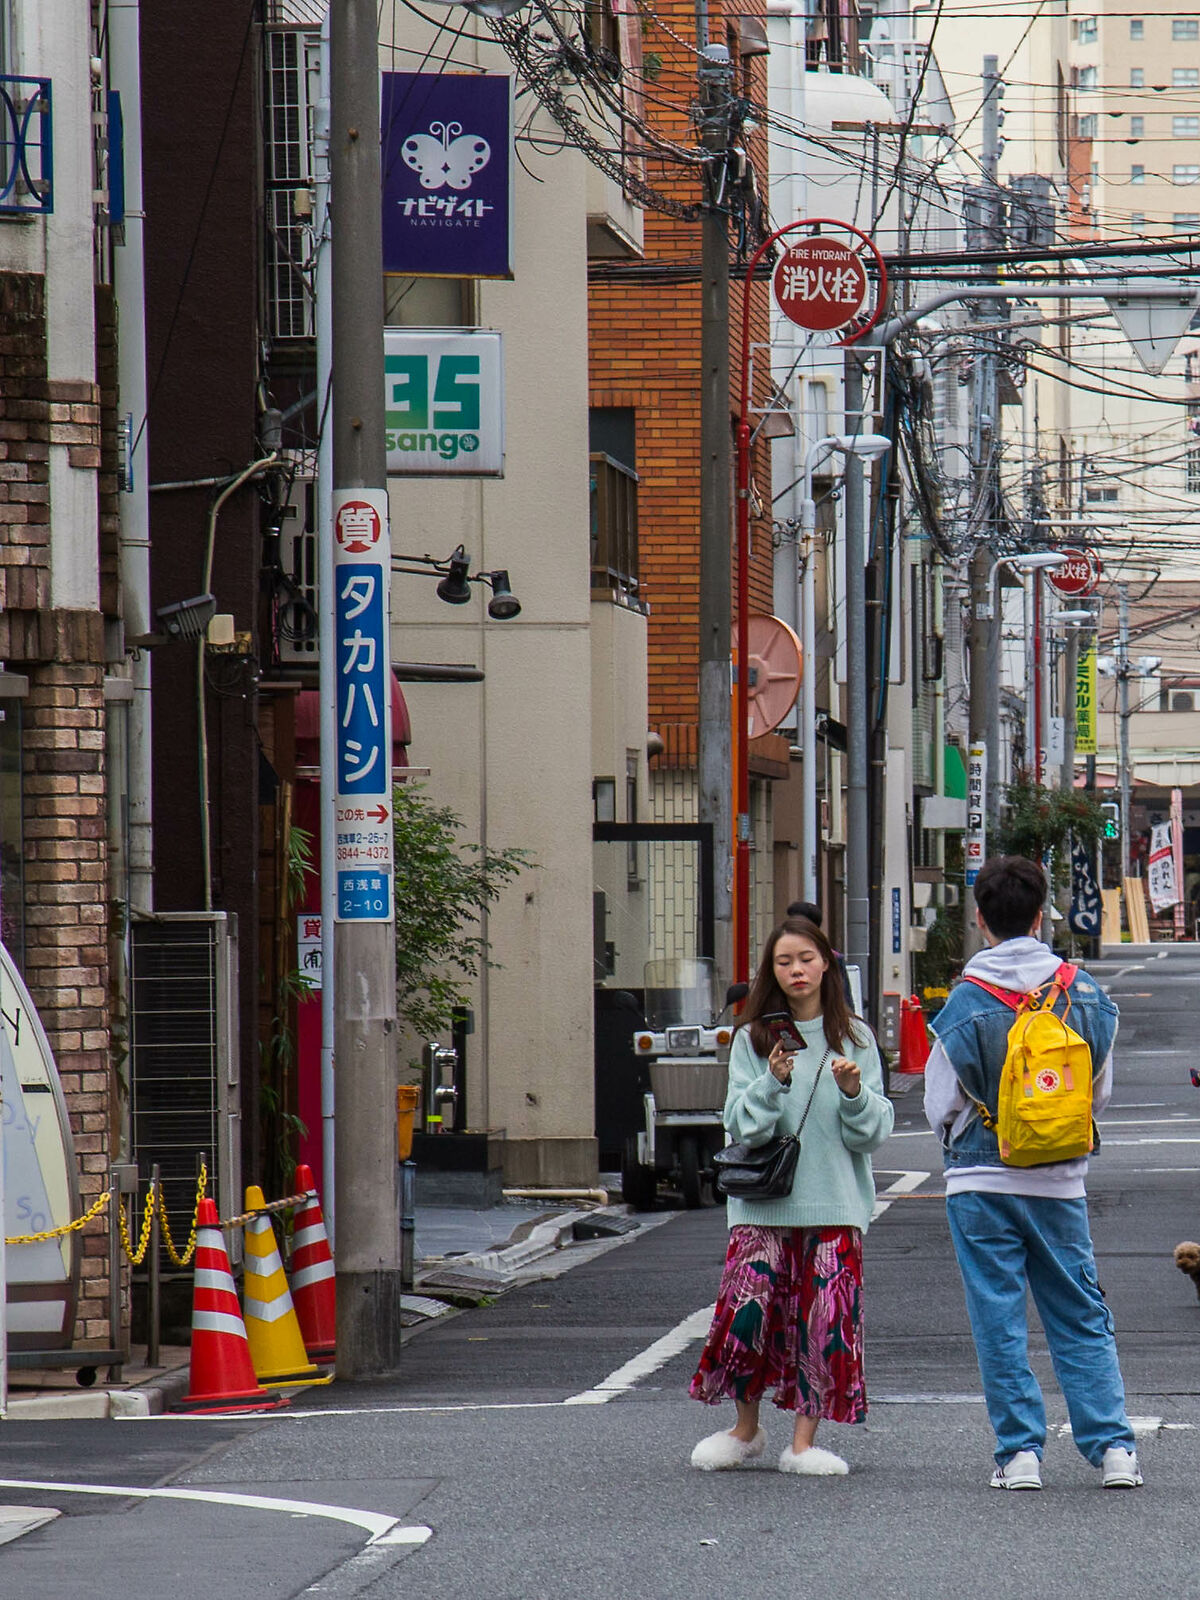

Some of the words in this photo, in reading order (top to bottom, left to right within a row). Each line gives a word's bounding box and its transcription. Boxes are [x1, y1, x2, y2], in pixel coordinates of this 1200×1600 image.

[397, 195, 494, 217] ナビゲイト
[410, 219, 480, 228] NAVIGATE
[790, 248, 810, 260] FIRE
[812, 249, 852, 261] HYDRANT
[782, 265, 860, 303] 消火栓
[385, 432, 480, 460] sango
[338, 506, 377, 546] 質
[341, 575, 379, 783] タカハシ
[337, 808, 365, 821] この先
[336, 847, 390, 860] 3844-4372
[343, 879, 382, 891] 西浅草
[343, 900, 383, 912] 2-10
